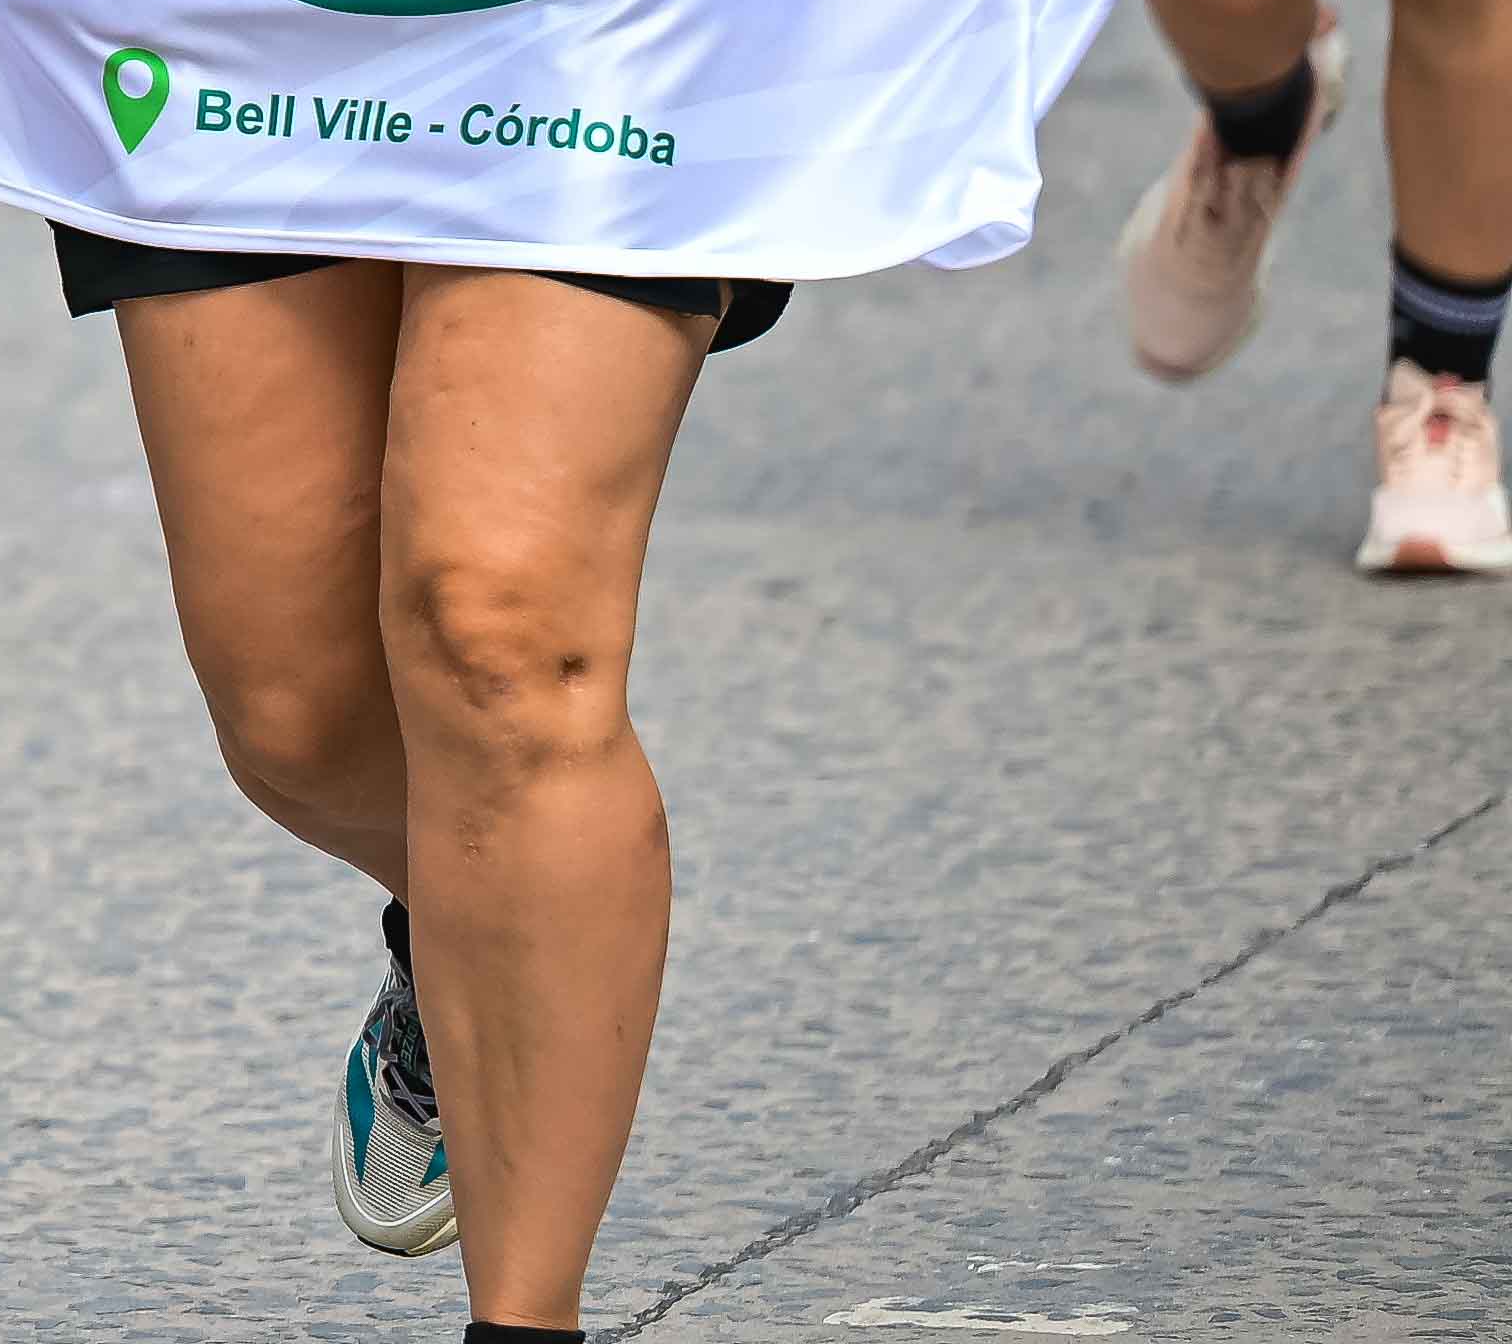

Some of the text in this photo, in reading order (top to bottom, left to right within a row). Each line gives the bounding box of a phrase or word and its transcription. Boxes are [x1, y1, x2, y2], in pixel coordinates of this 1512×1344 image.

[195, 88, 677, 168] Bell Ville - Córdoba
